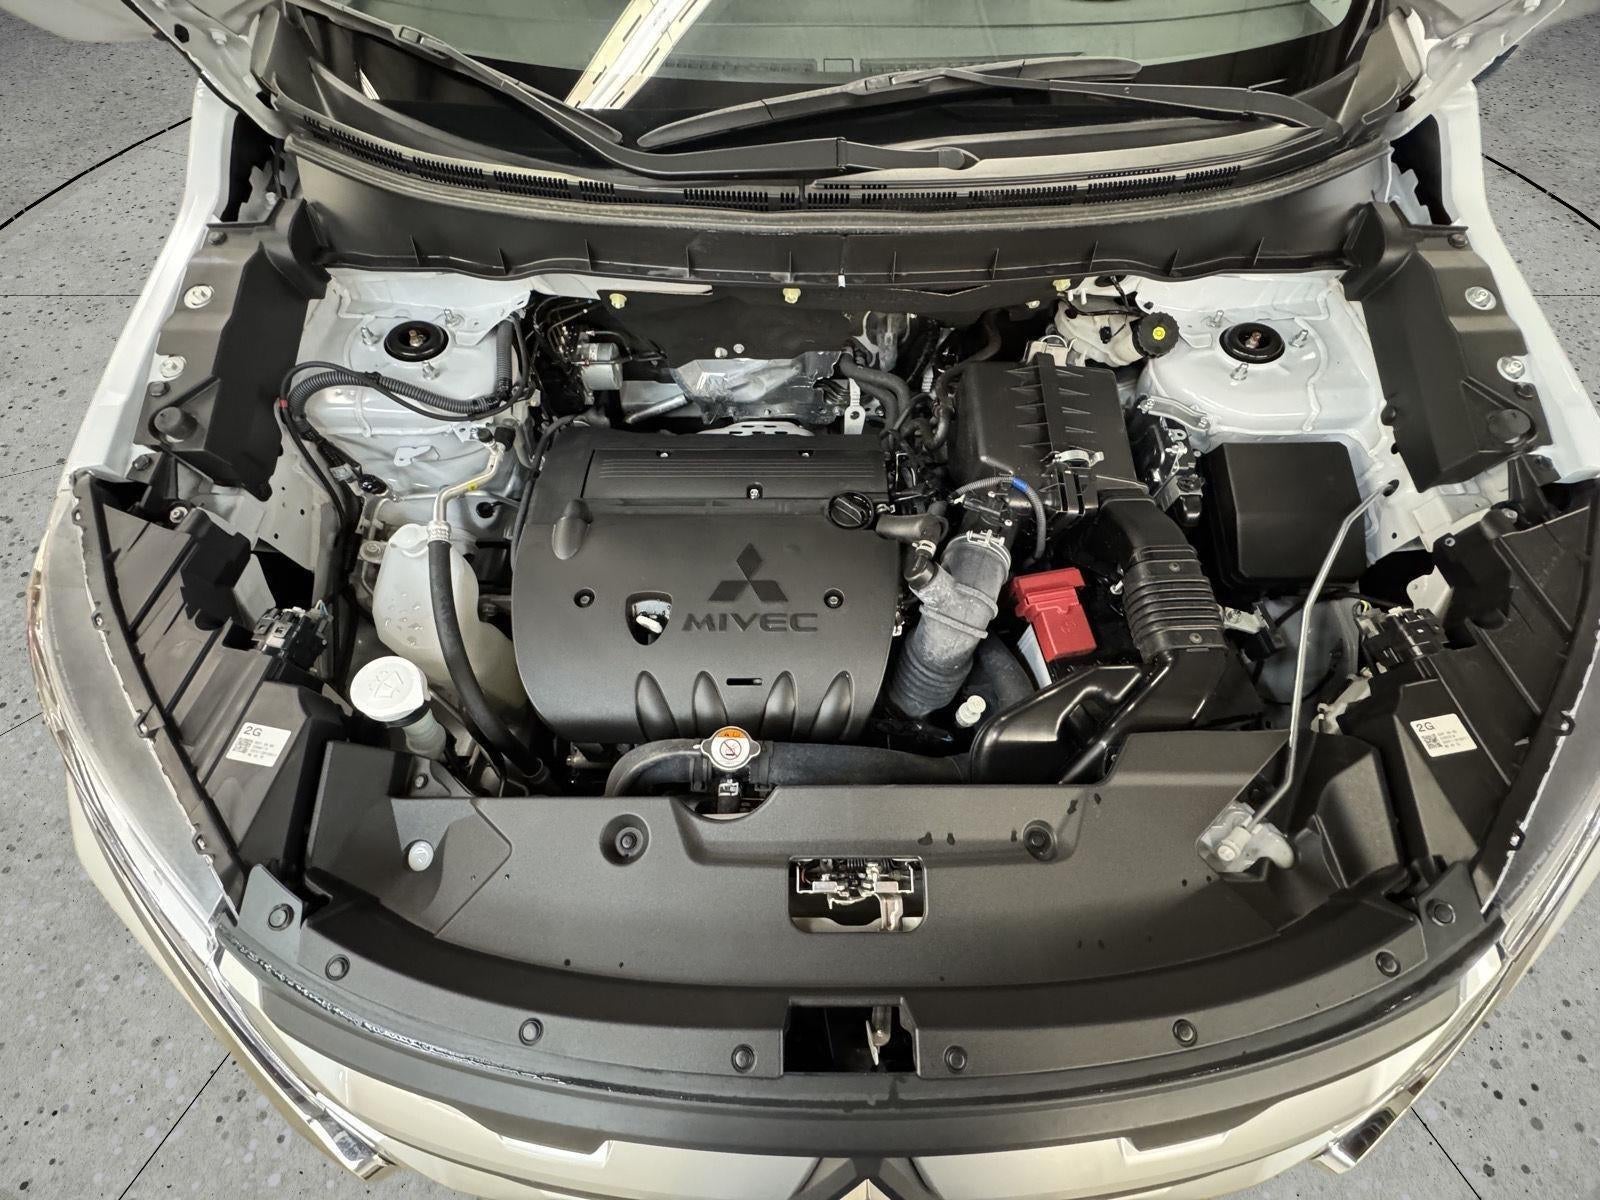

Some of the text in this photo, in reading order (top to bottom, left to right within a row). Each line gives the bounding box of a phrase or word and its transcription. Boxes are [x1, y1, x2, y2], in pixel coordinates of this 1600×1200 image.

[681, 613, 818, 632] MIVEC
[243, 725, 263, 737] 2G
[1416, 721, 1435, 733] 2G
